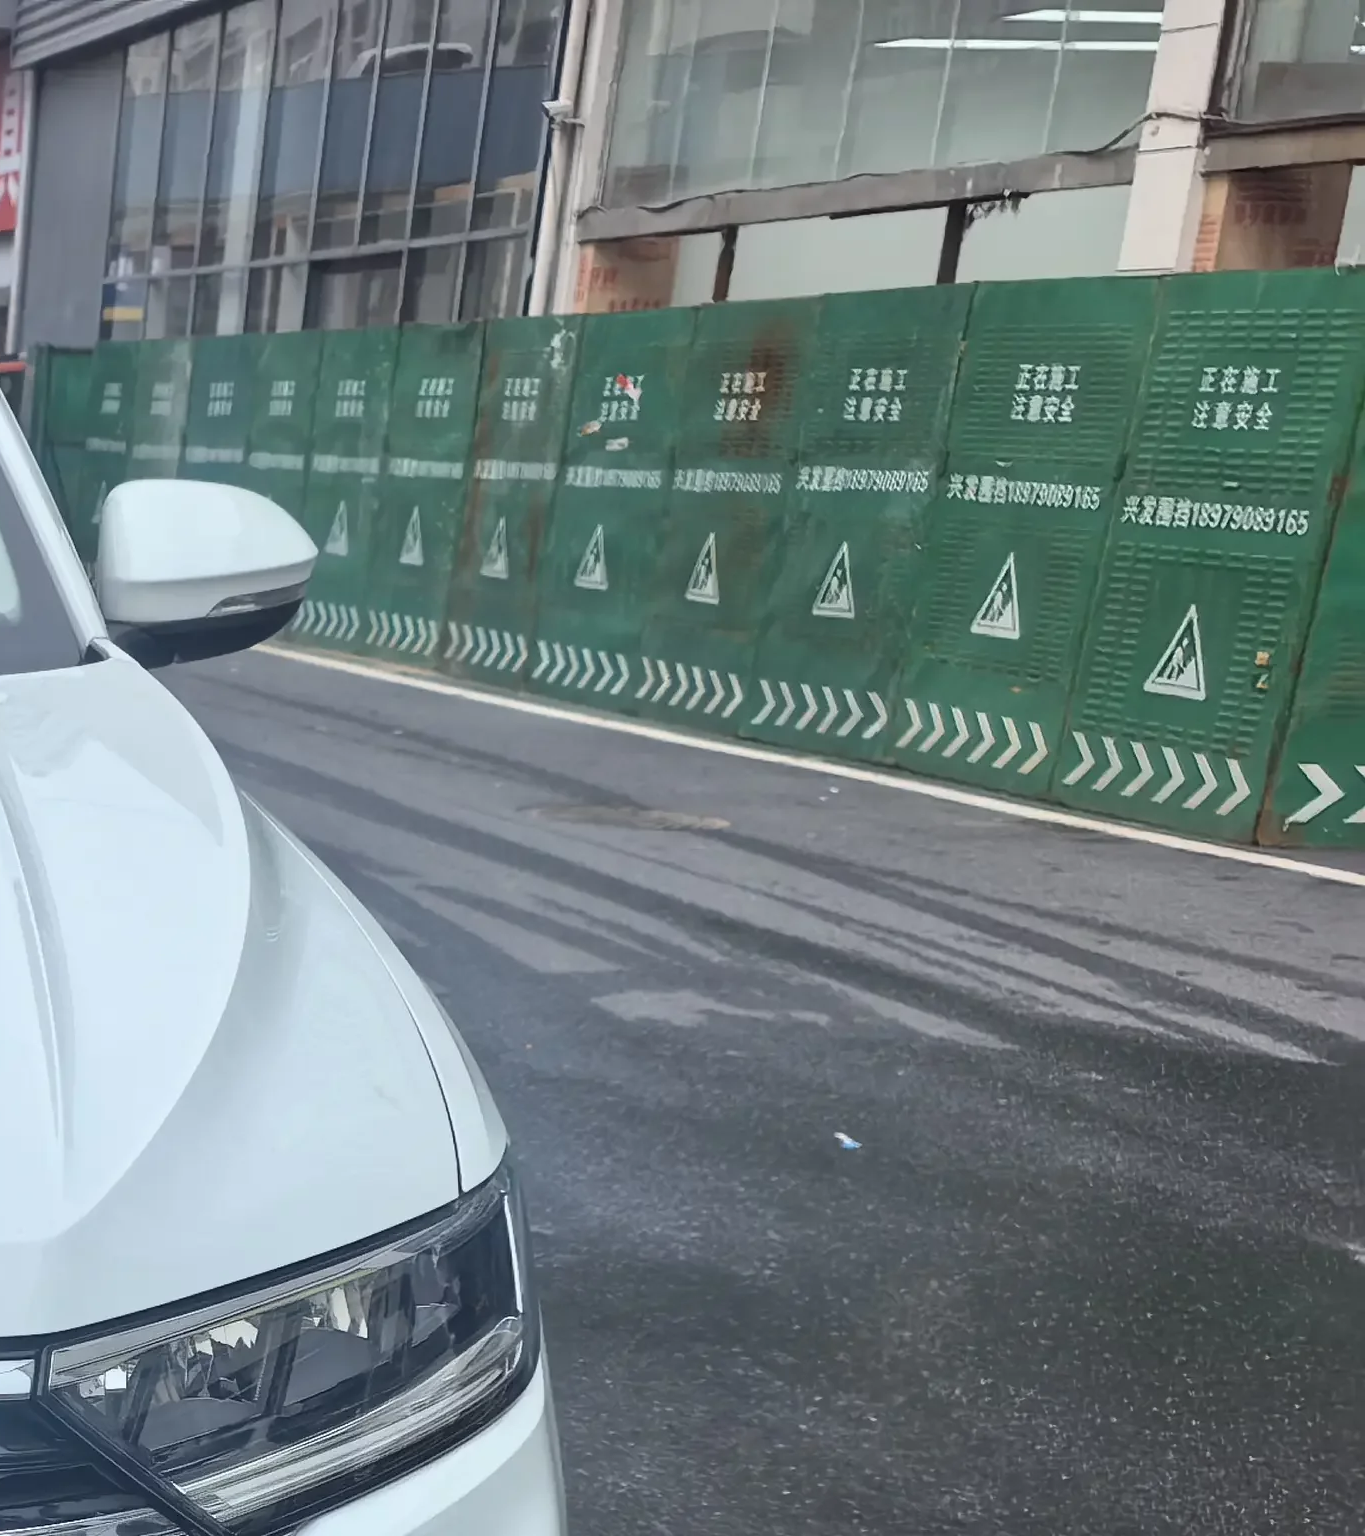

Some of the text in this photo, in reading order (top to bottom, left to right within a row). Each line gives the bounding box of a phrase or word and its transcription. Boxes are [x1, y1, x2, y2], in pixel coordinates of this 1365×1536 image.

[1013, 364, 1081, 392] 正在施工
[1198, 365, 1281, 395] 正在施工
[1010, 393, 1075, 424] 注意安全
[1191, 400, 1273, 430] 注意安全
